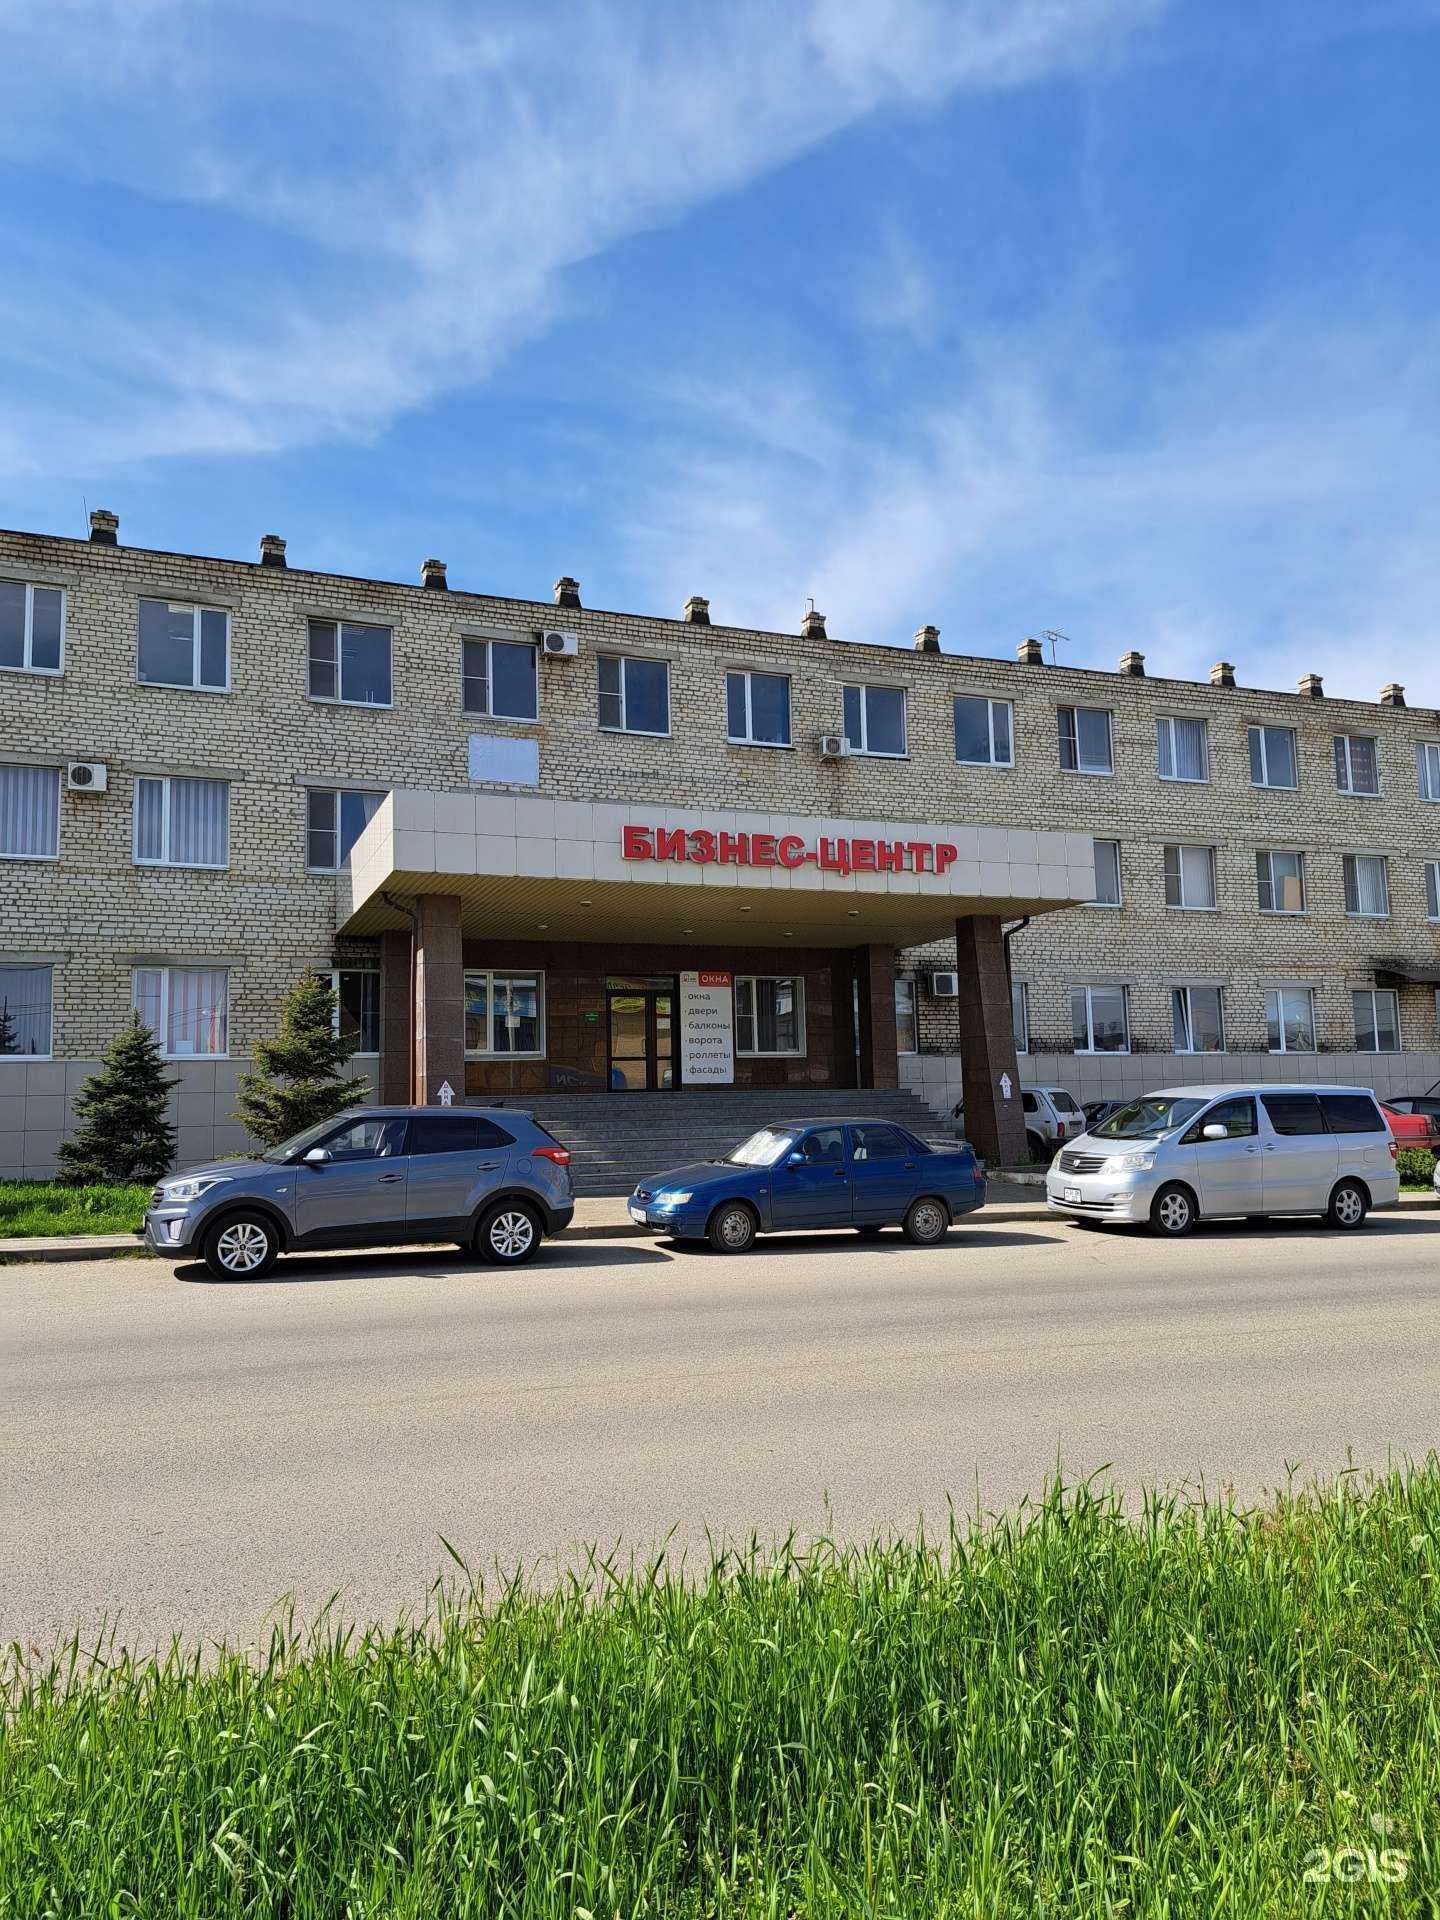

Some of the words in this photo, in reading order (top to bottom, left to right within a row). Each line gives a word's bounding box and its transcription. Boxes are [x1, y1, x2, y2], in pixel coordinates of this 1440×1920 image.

[622, 825, 958, 876] БИЗНЕС-ЦЕНТР
[701, 975, 729, 983] ОКНА
[688, 1008, 718, 1016] двери
[688, 1021, 730, 1029] балконы
[688, 1037, 722, 1046] ворота
[689, 1052, 730, 1061] роллеты
[689, 1065, 727, 1074] фасады
